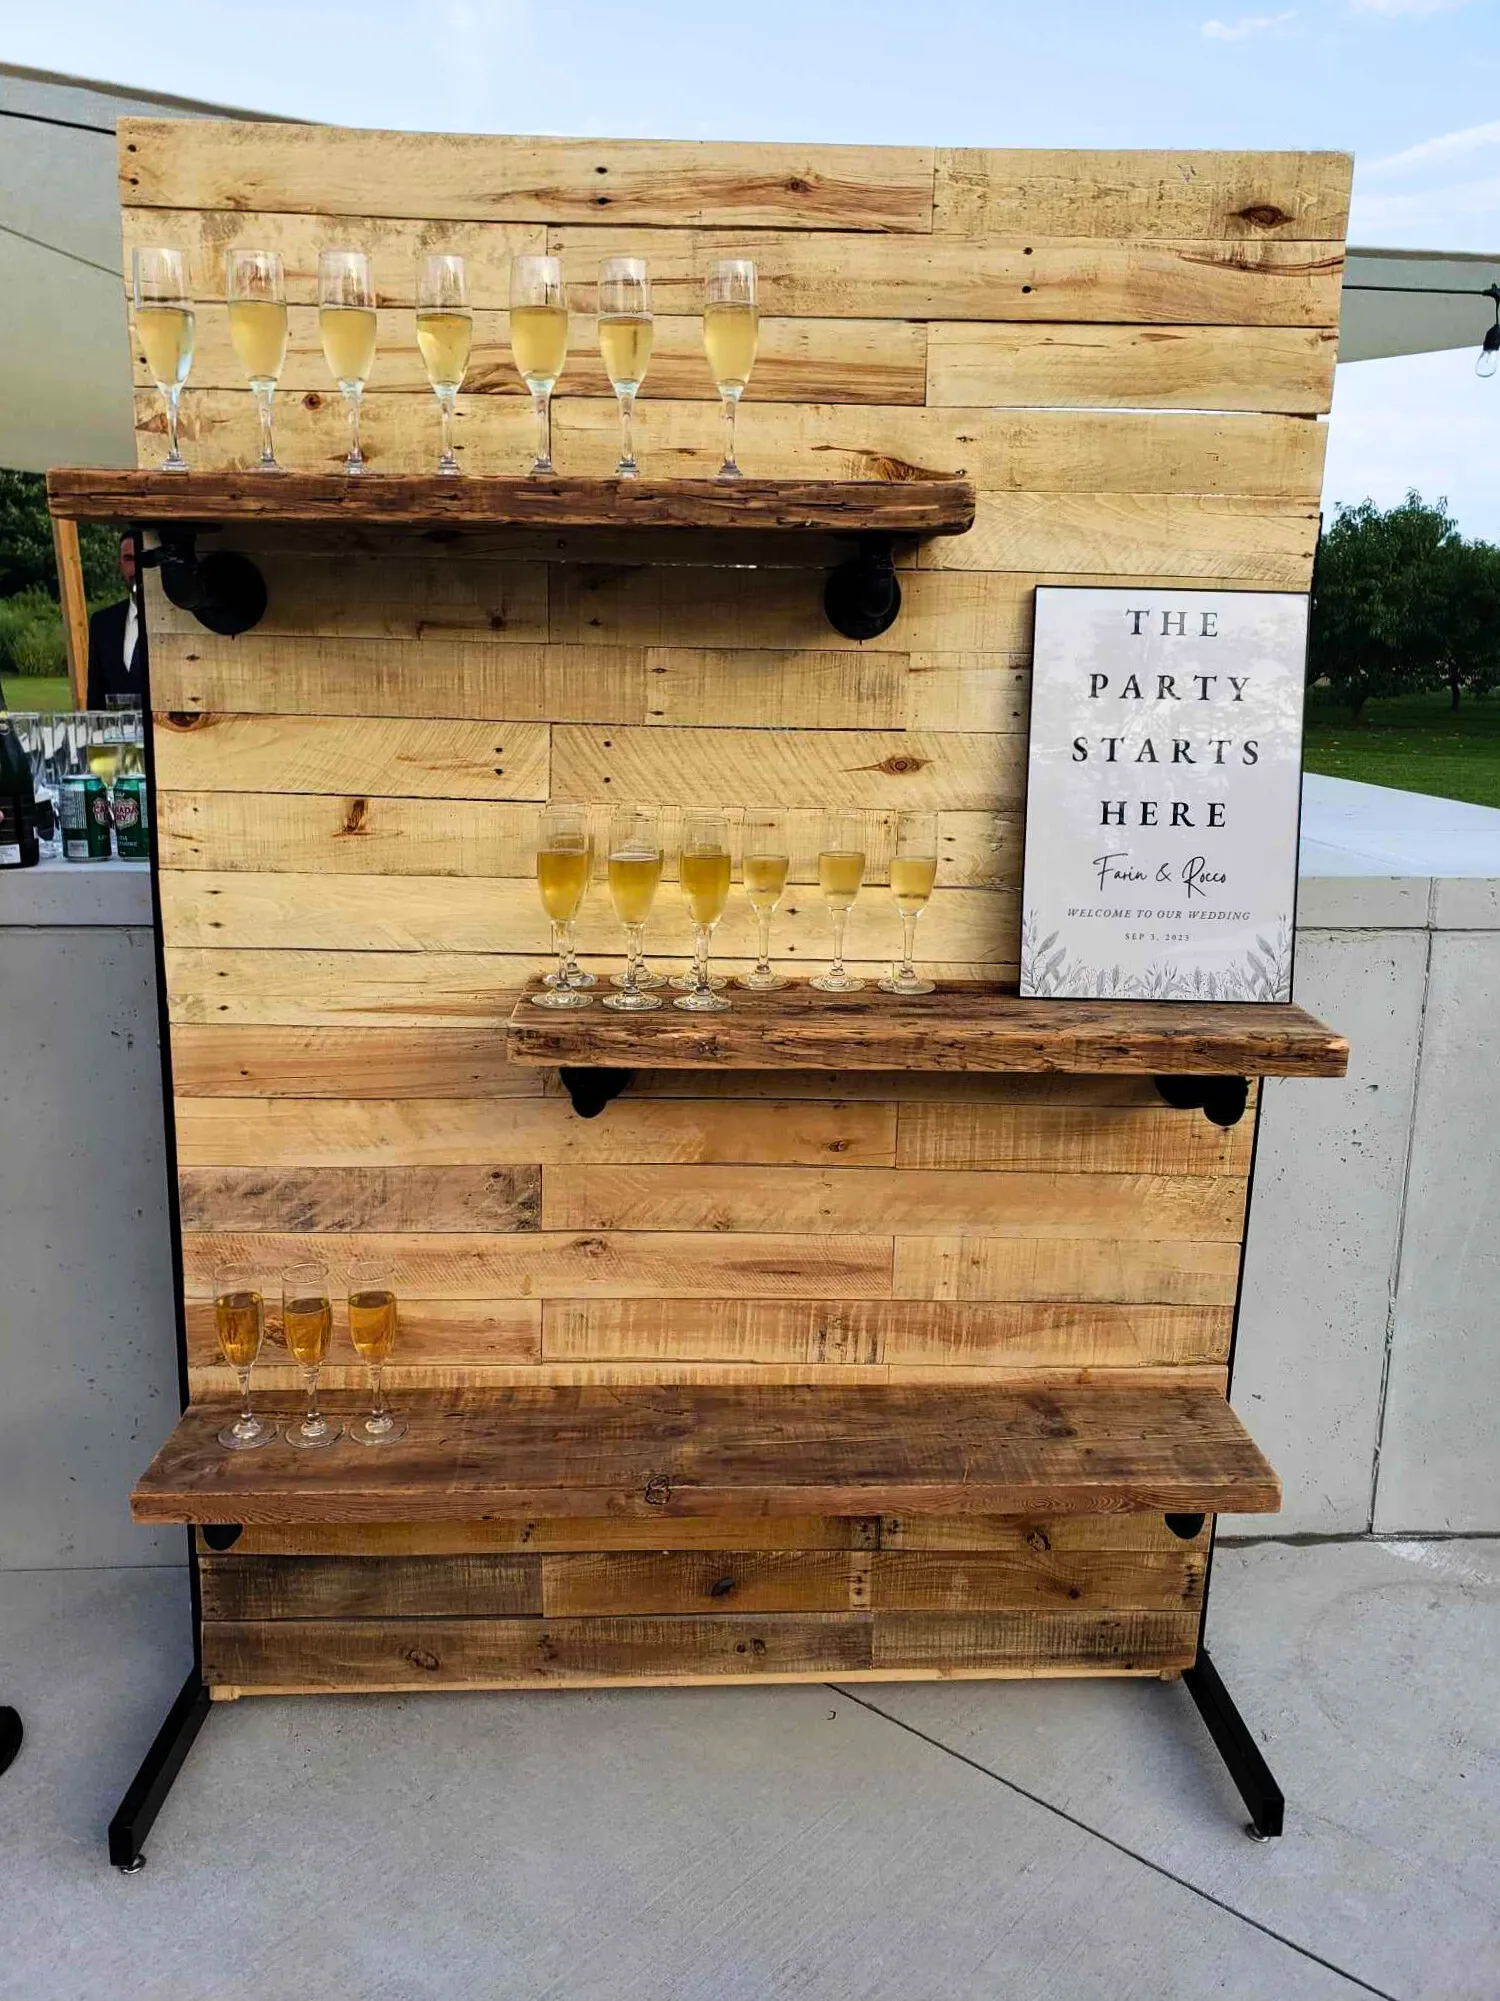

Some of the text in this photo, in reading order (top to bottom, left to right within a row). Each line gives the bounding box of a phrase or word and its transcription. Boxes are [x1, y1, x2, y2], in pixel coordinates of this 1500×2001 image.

[1126, 609, 1218, 637] THE
[1088, 673, 1251, 701] PARTY
[1072, 737, 1259, 765] STARTS
[1100, 801, 1226, 827] HERE
[1092, 853, 1227, 898] Farin & Rocco
[1067, 908, 1251, 921] WELCOME TO OUR WEDDING
[1125, 933, 1145, 941] SEP
